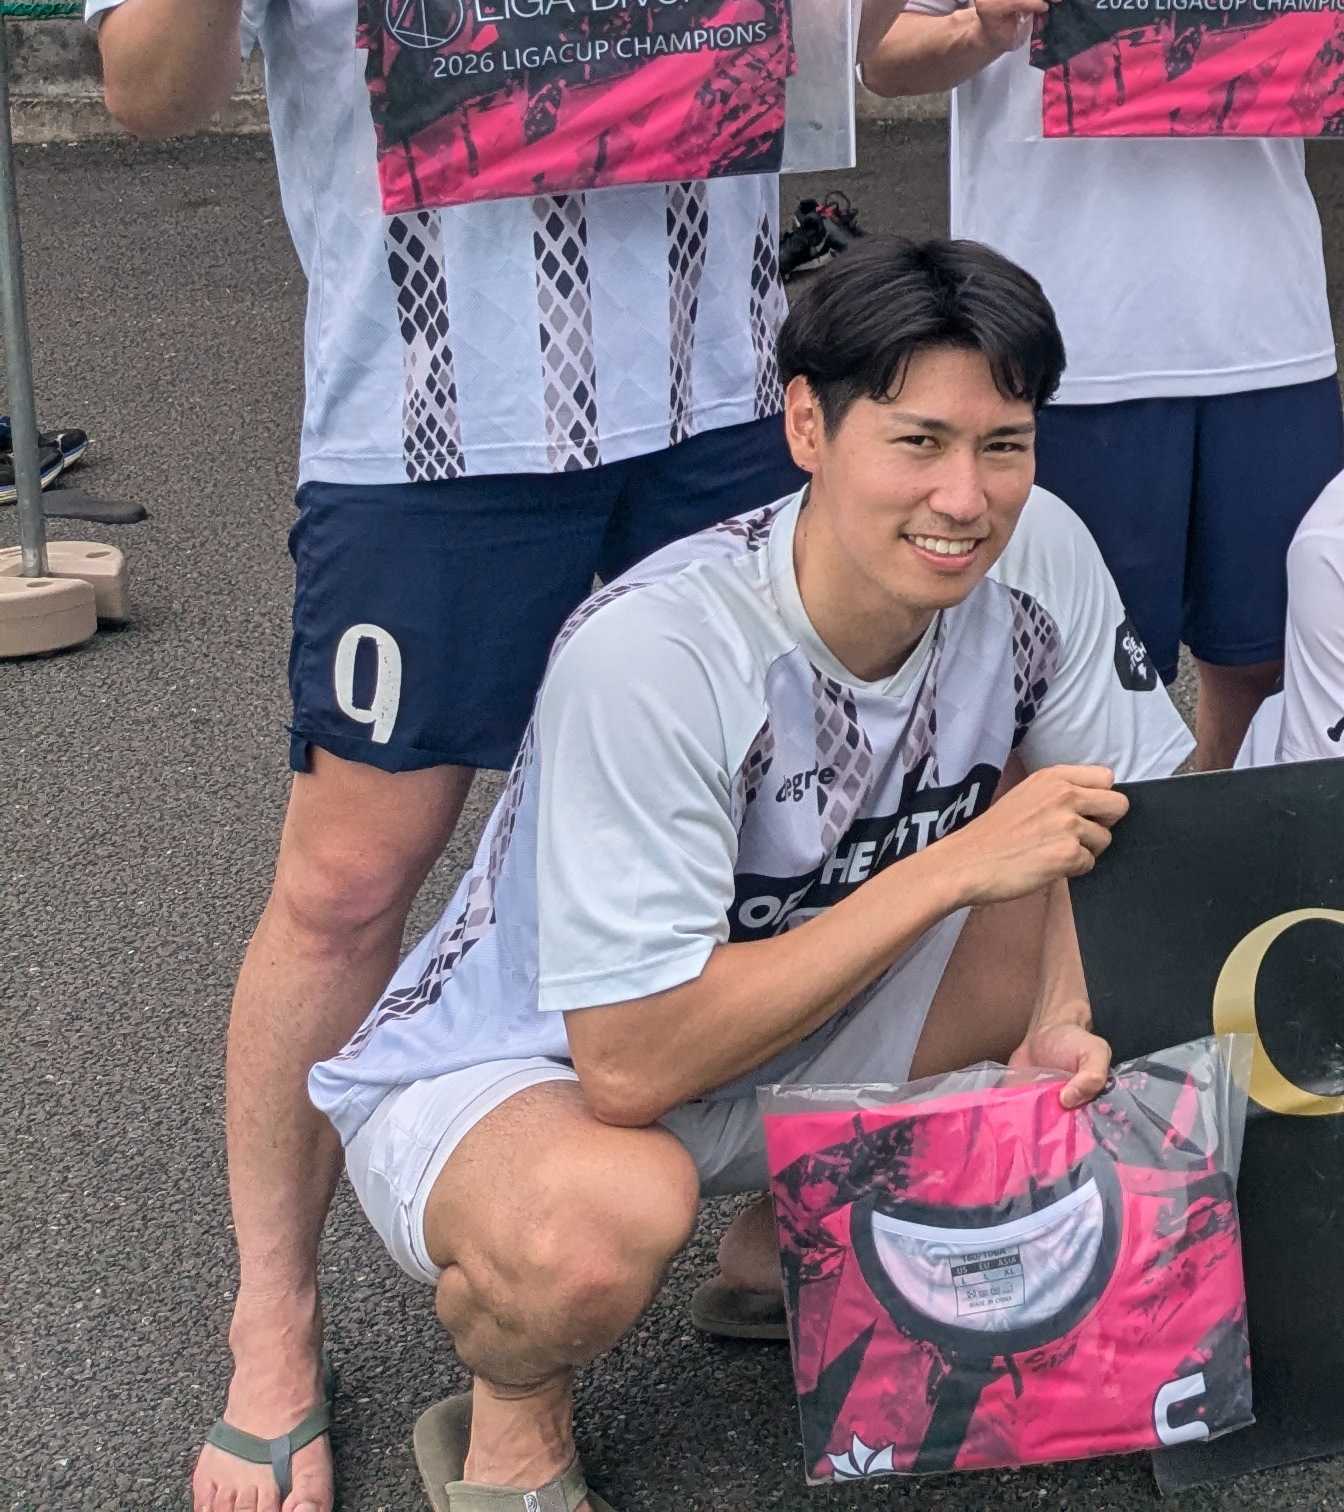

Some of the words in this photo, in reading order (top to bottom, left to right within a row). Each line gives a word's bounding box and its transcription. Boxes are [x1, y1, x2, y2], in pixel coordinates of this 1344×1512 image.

[432, 52, 495, 79] 2026
[501, 38, 609, 71] LIGACUP
[615, 21, 768, 60] CHAMPIONS
